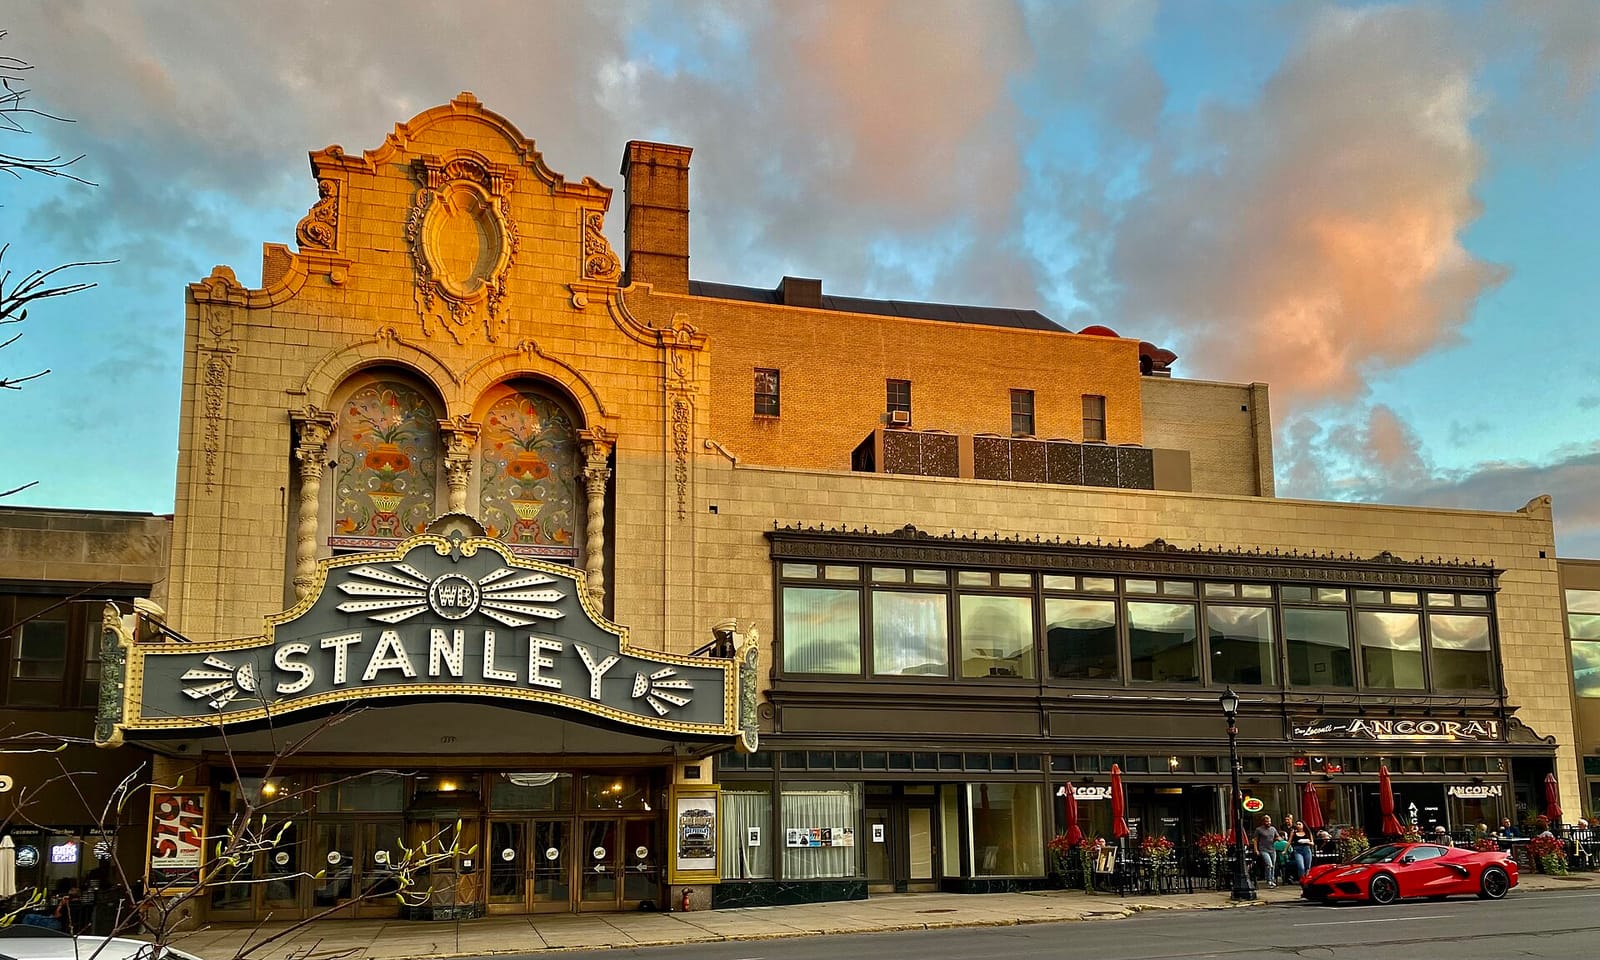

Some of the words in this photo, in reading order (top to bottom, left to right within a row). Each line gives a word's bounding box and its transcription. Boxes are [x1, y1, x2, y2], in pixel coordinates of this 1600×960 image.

[438, 584, 472, 607] WB
[273, 627, 622, 701] STANLEY
[1345, 718, 1499, 740] ANCORA!
[1448, 785, 1503, 798] ANCORA!
